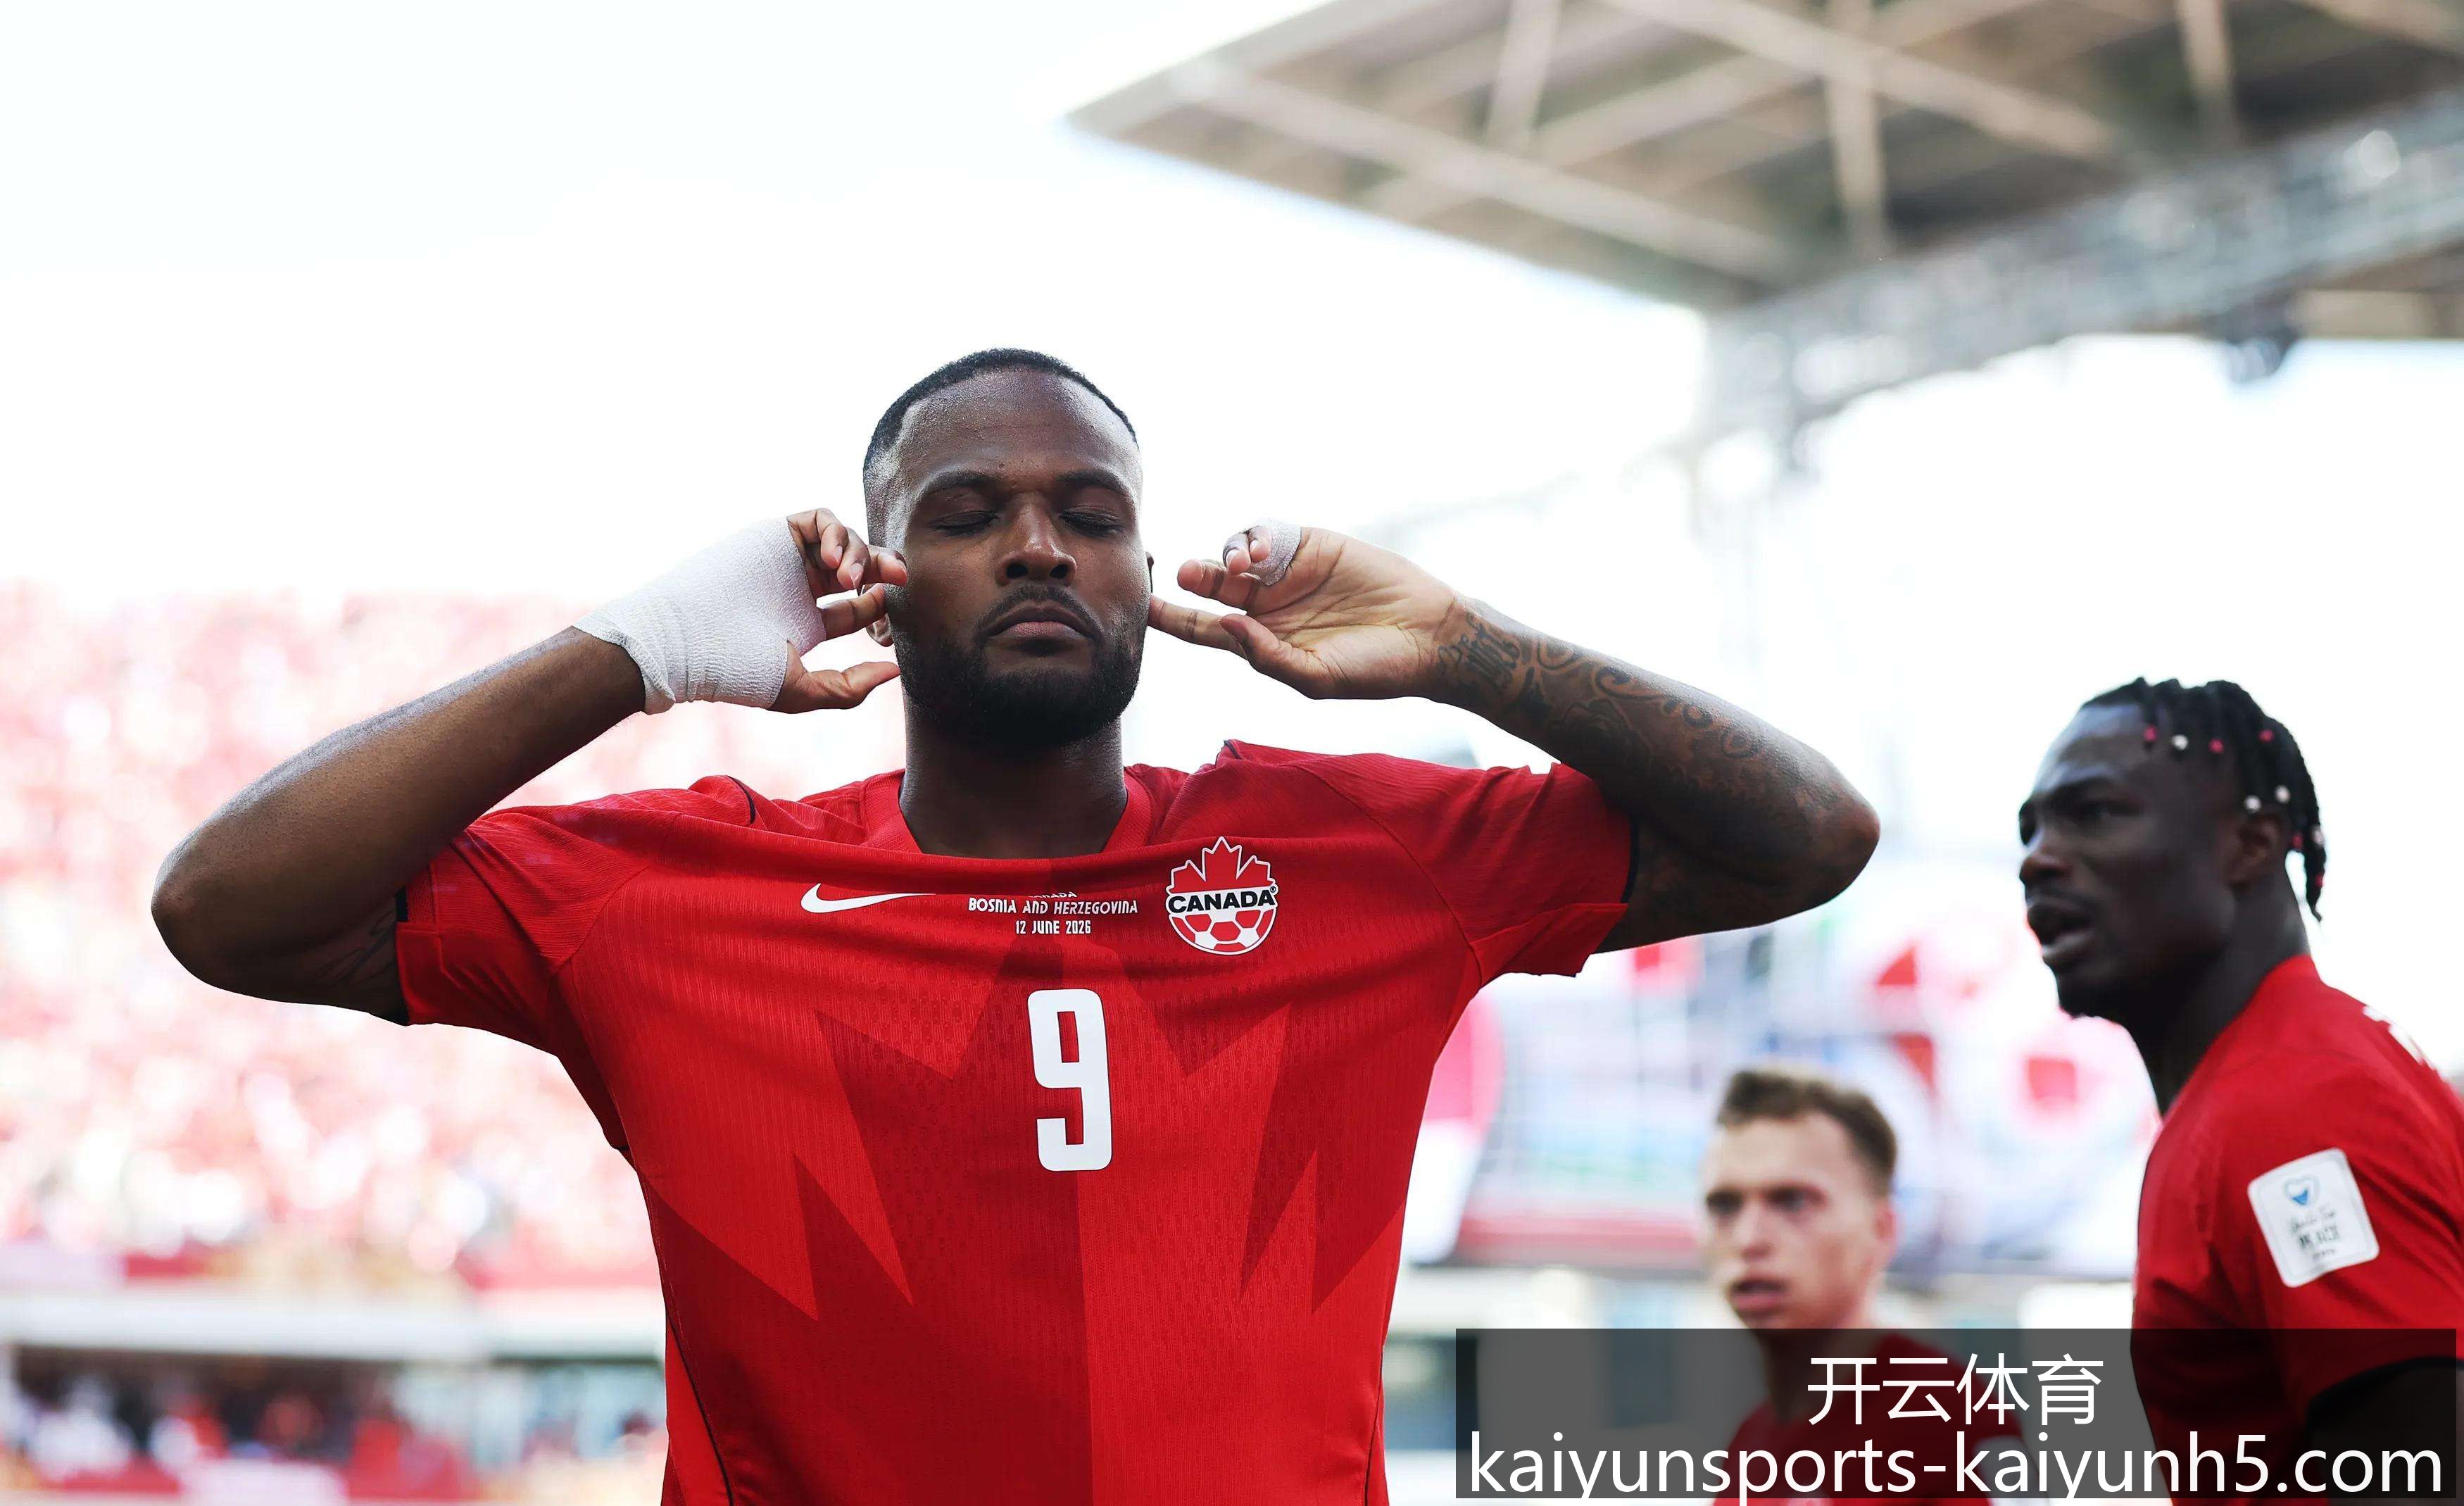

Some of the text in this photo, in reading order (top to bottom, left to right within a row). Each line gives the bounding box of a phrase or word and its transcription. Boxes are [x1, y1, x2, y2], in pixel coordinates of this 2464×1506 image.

[968, 897, 1138, 915] BOSNIA AND HERZEGOVINA
[1168, 889, 1276, 914] CANADA
[1015, 920, 1092, 934] 12 JUNE 2026
[1027, 989, 1112, 1172] 9
